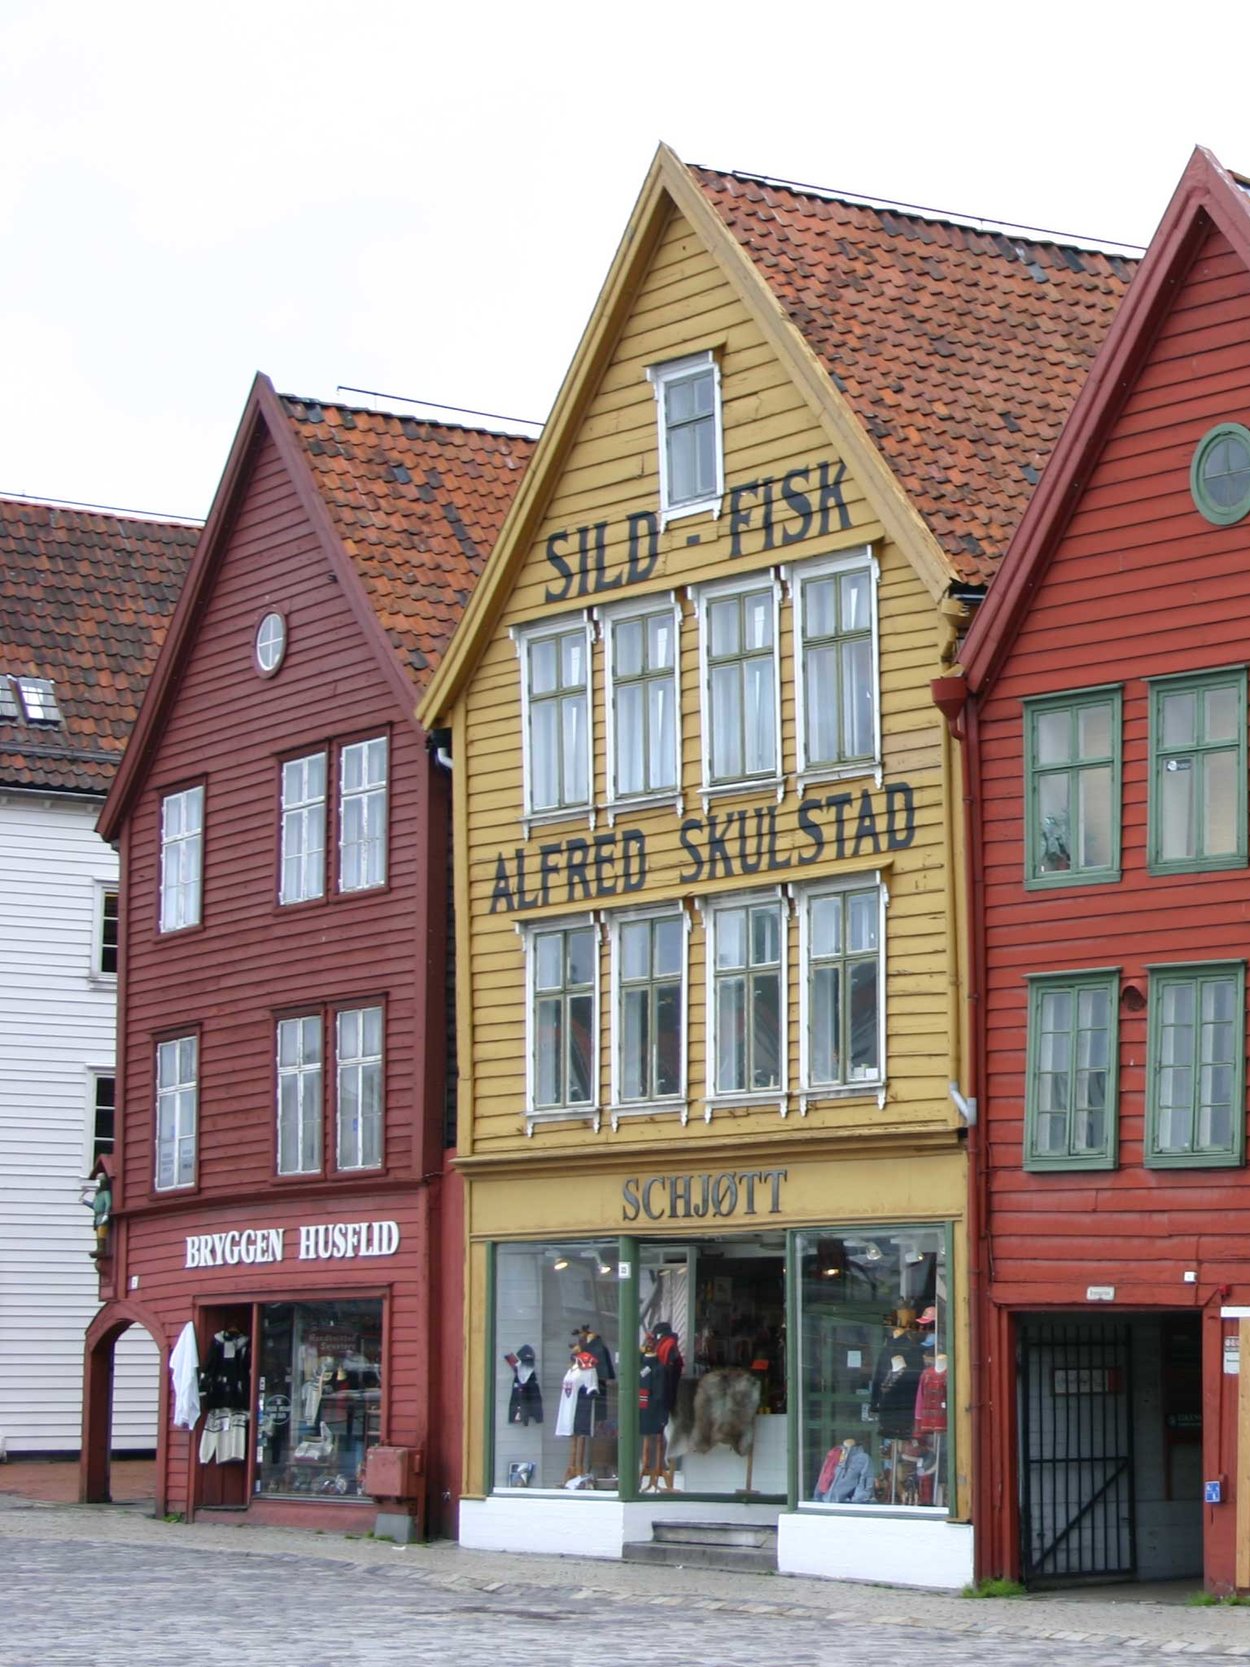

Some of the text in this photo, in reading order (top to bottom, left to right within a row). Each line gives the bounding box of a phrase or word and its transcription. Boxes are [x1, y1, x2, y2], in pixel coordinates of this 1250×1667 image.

[545, 511, 659, 602] SILD
[729, 459, 854, 559] FISK
[490, 781, 916, 914] ALFRED SKULSTAD
[622, 1169, 788, 1221] SCHJØTT
[185, 1220, 400, 1269] BRYGGEN HUSFLID
